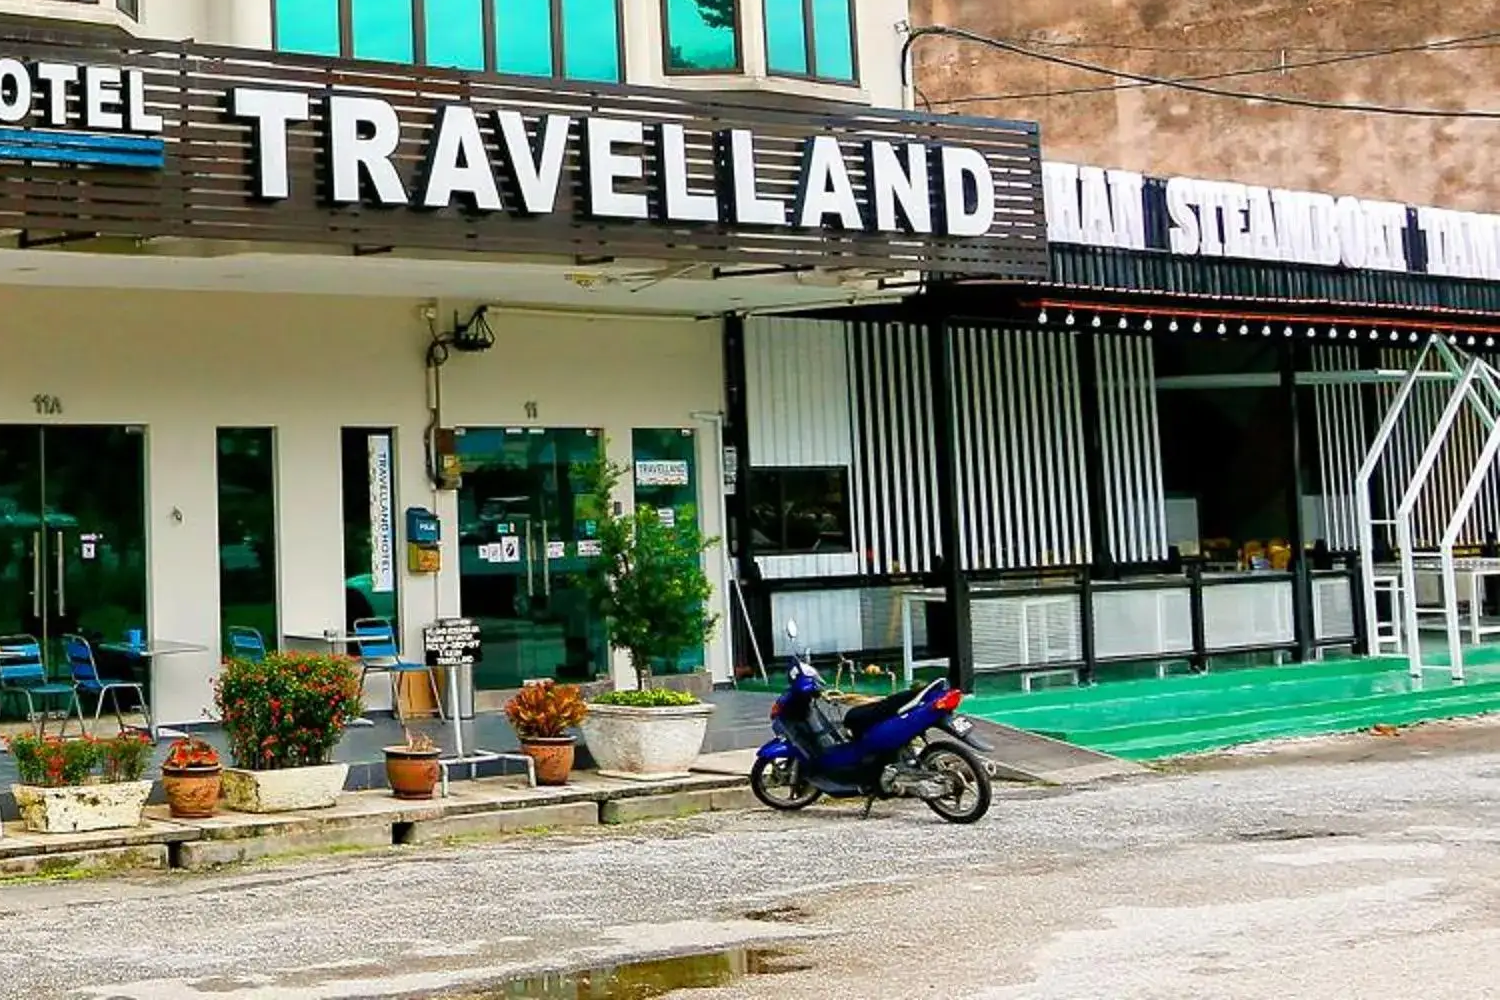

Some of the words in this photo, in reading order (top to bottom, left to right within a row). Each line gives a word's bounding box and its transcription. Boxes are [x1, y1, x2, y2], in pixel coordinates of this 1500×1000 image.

[233, 87, 997, 237] TRAVELLAND
[1166, 176, 1407, 272] STEAMBOAT
[32, 394, 63, 414] 11A
[524, 400, 538, 419] 11
